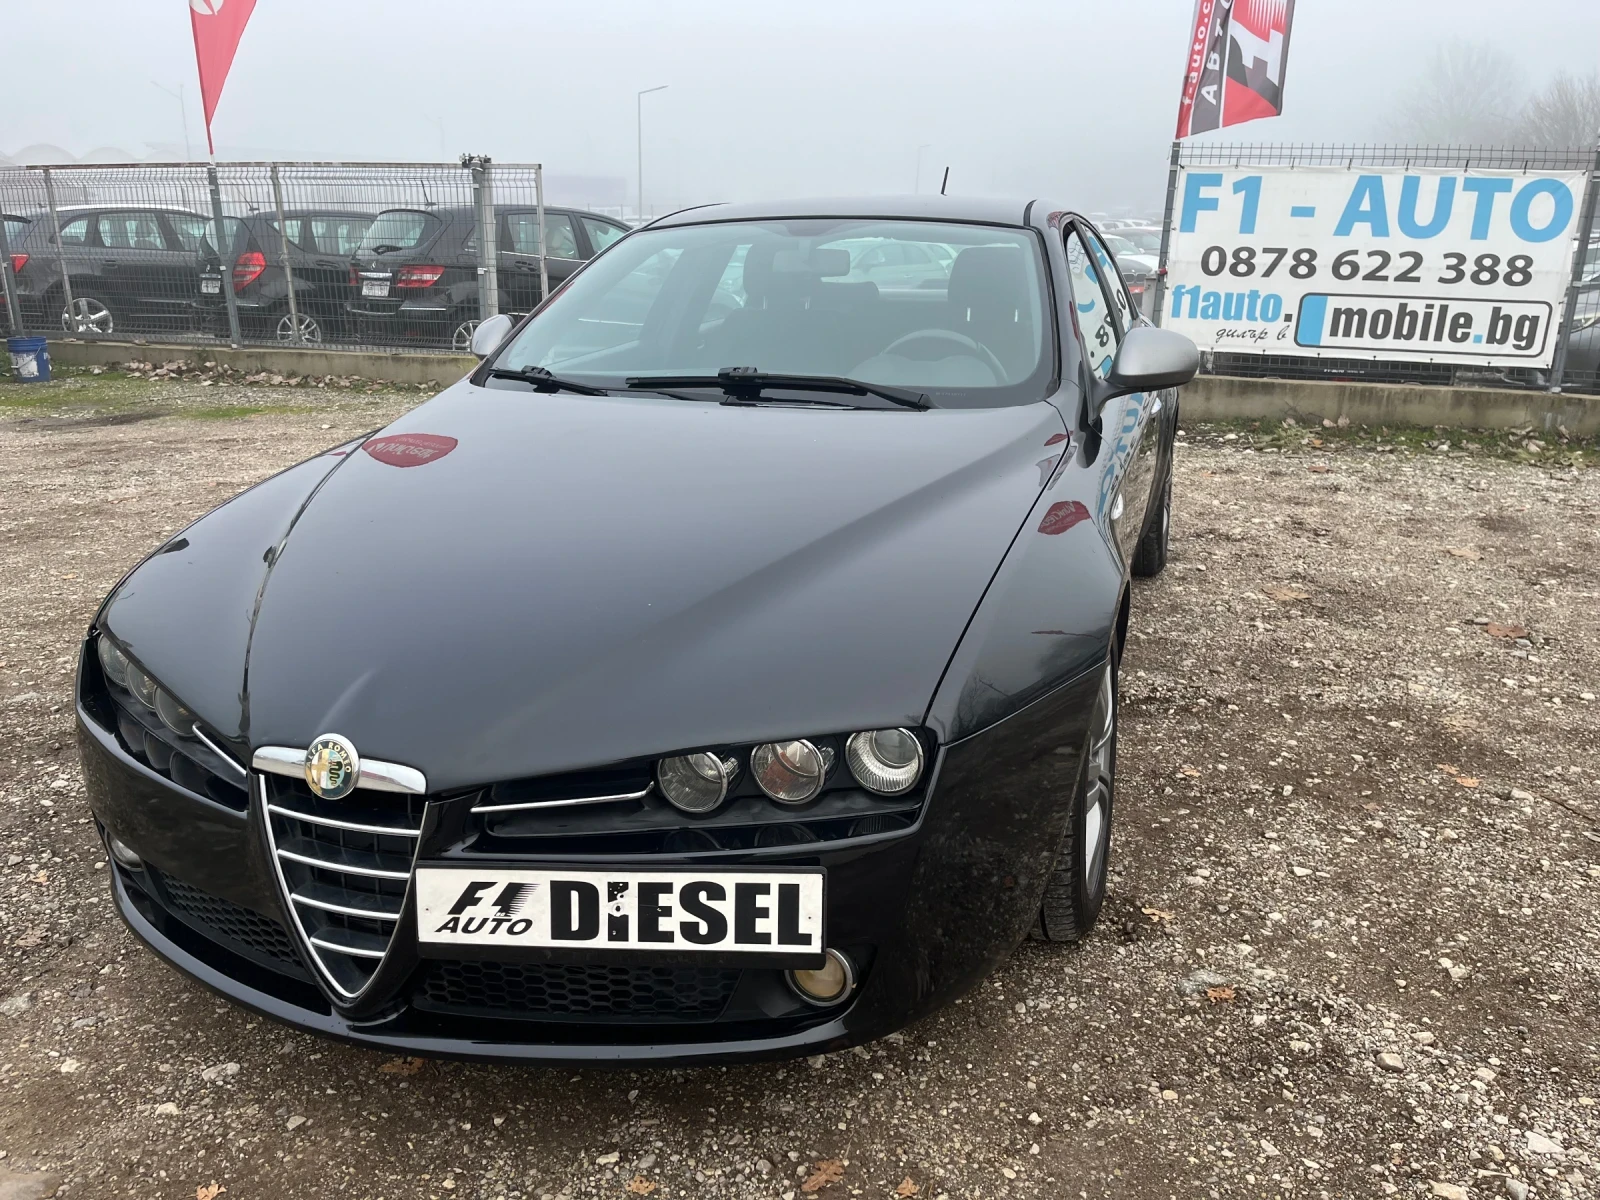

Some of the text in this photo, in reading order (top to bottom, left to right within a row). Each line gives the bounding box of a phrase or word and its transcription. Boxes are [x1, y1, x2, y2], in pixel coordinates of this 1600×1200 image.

[1179, 173, 1263, 235] F1
[1333, 175, 1573, 243] AUTO
[1200, 246, 1534, 286] 0878 622 388
[1329, 303, 1540, 351] mobile.bg
[328, 742, 351, 773] ROMEO
[434, 917, 533, 936] AUTO
[549, 880, 813, 945] DIESEL
